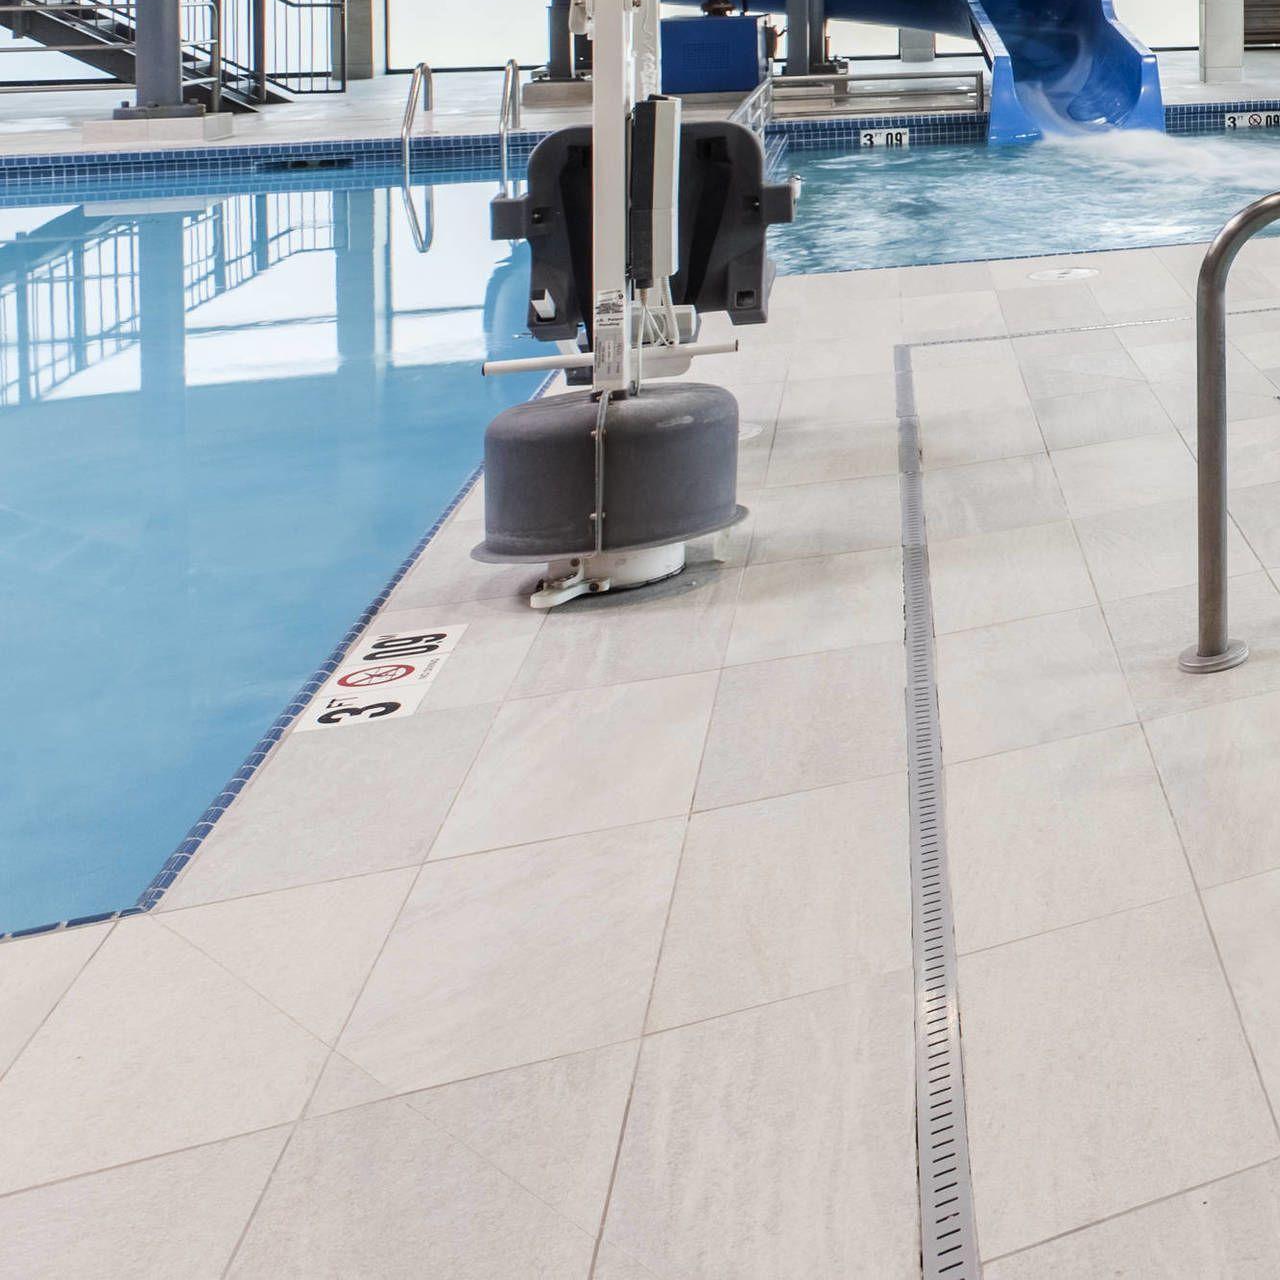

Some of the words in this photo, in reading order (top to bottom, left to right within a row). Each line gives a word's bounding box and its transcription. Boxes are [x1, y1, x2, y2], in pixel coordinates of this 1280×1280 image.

[1227, 116, 1236, 129] 3
[862, 133, 875, 146] 3
[326, 696, 358, 709] FT
[317, 701, 402, 724] 3
